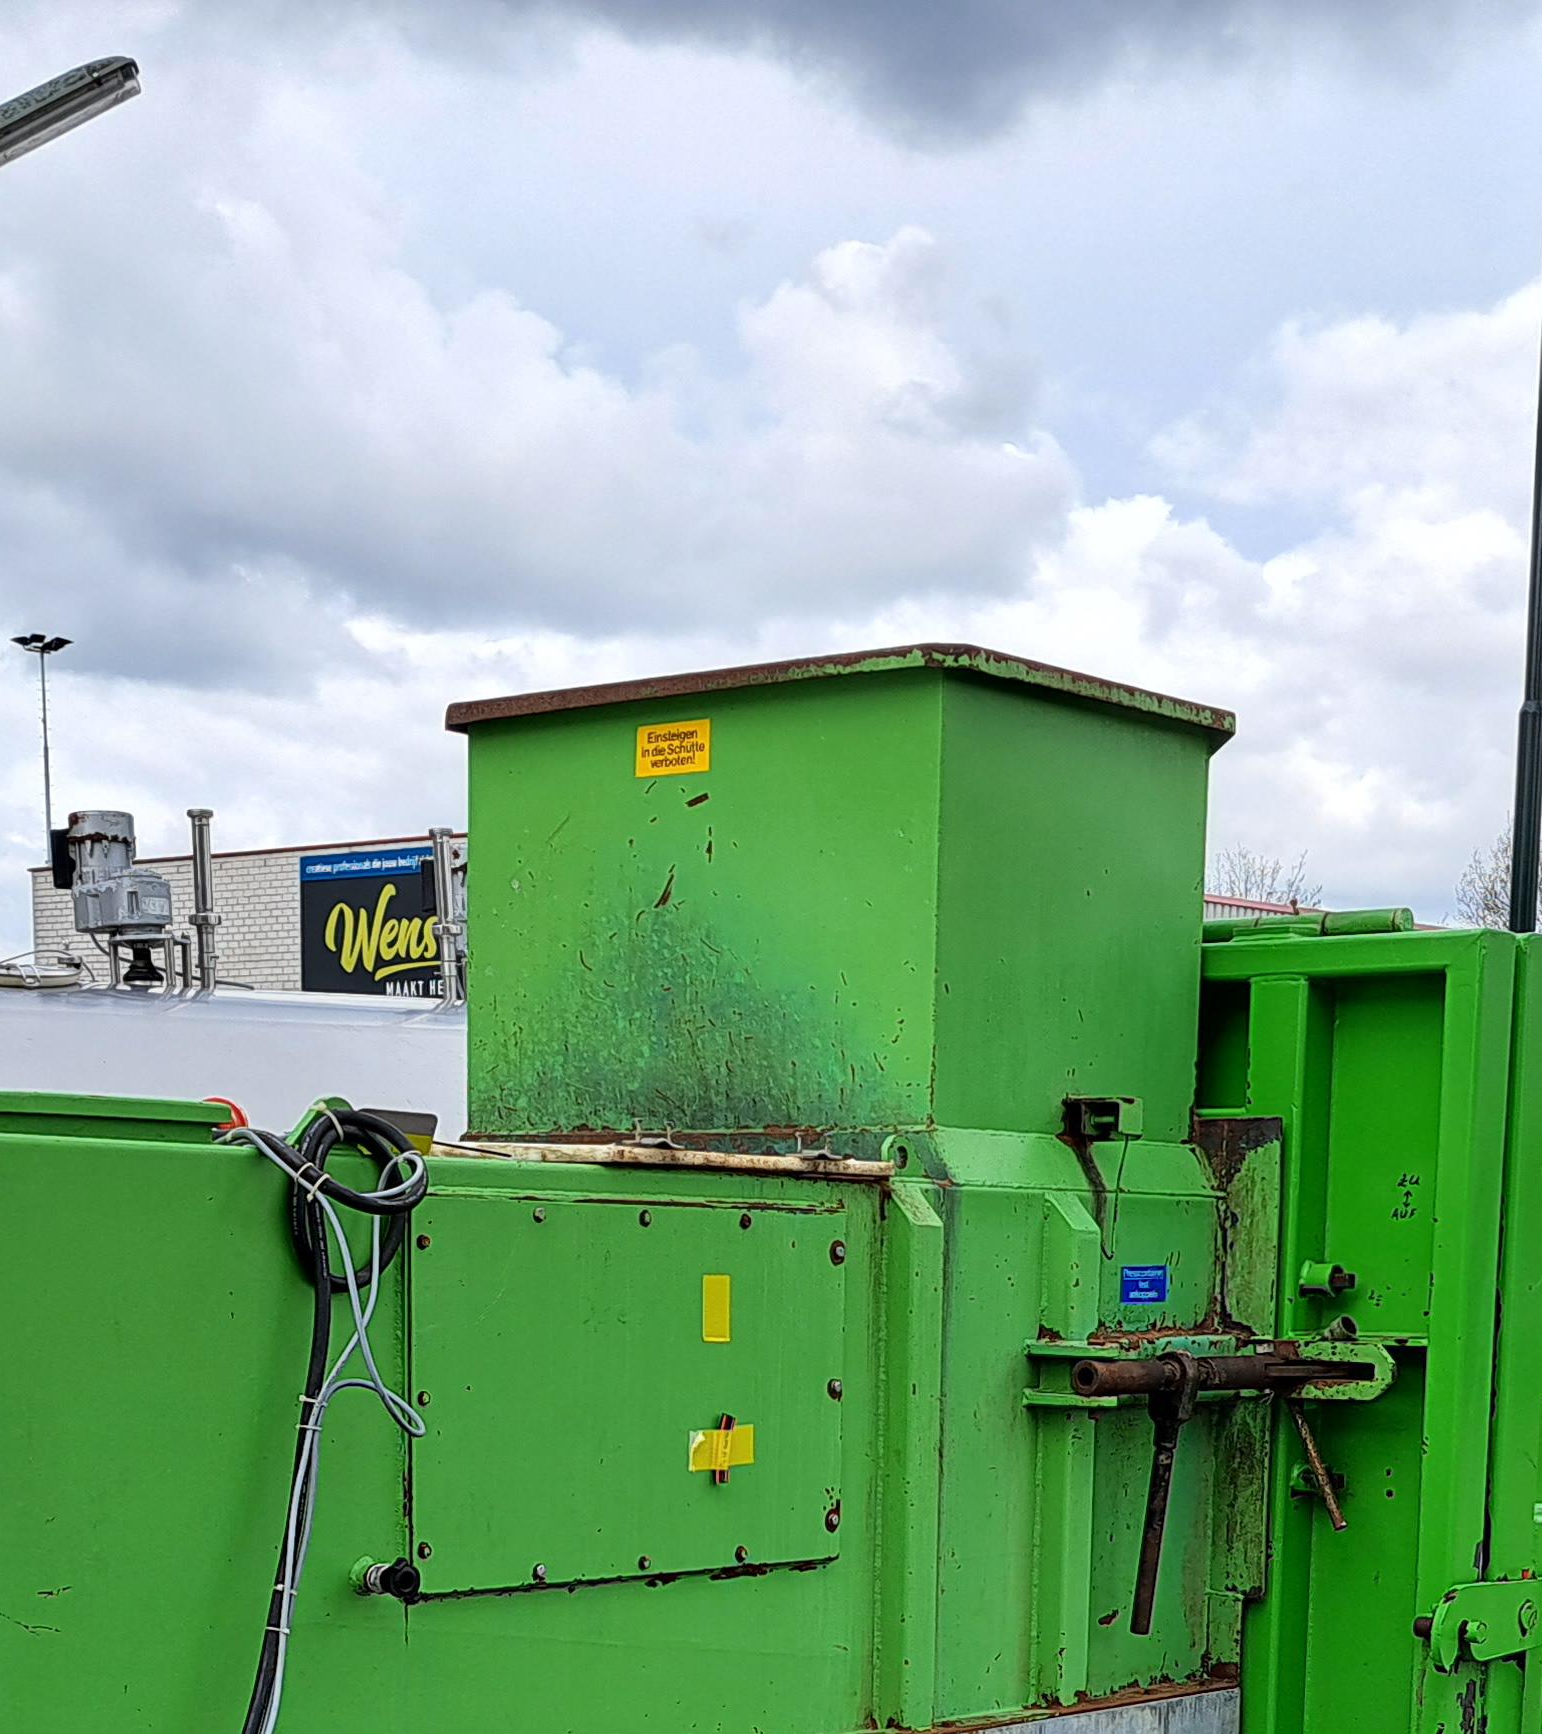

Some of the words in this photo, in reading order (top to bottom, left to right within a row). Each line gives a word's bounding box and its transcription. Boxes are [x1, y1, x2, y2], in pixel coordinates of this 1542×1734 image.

[647, 729, 698, 744] Einsteigen
[651, 745, 666, 757] die
[667, 741, 705, 755] Schütte
[386, 980, 425, 996] MAAKT
[429, 979, 444, 995] HE
[1391, 1207, 1417, 1220] AUF
